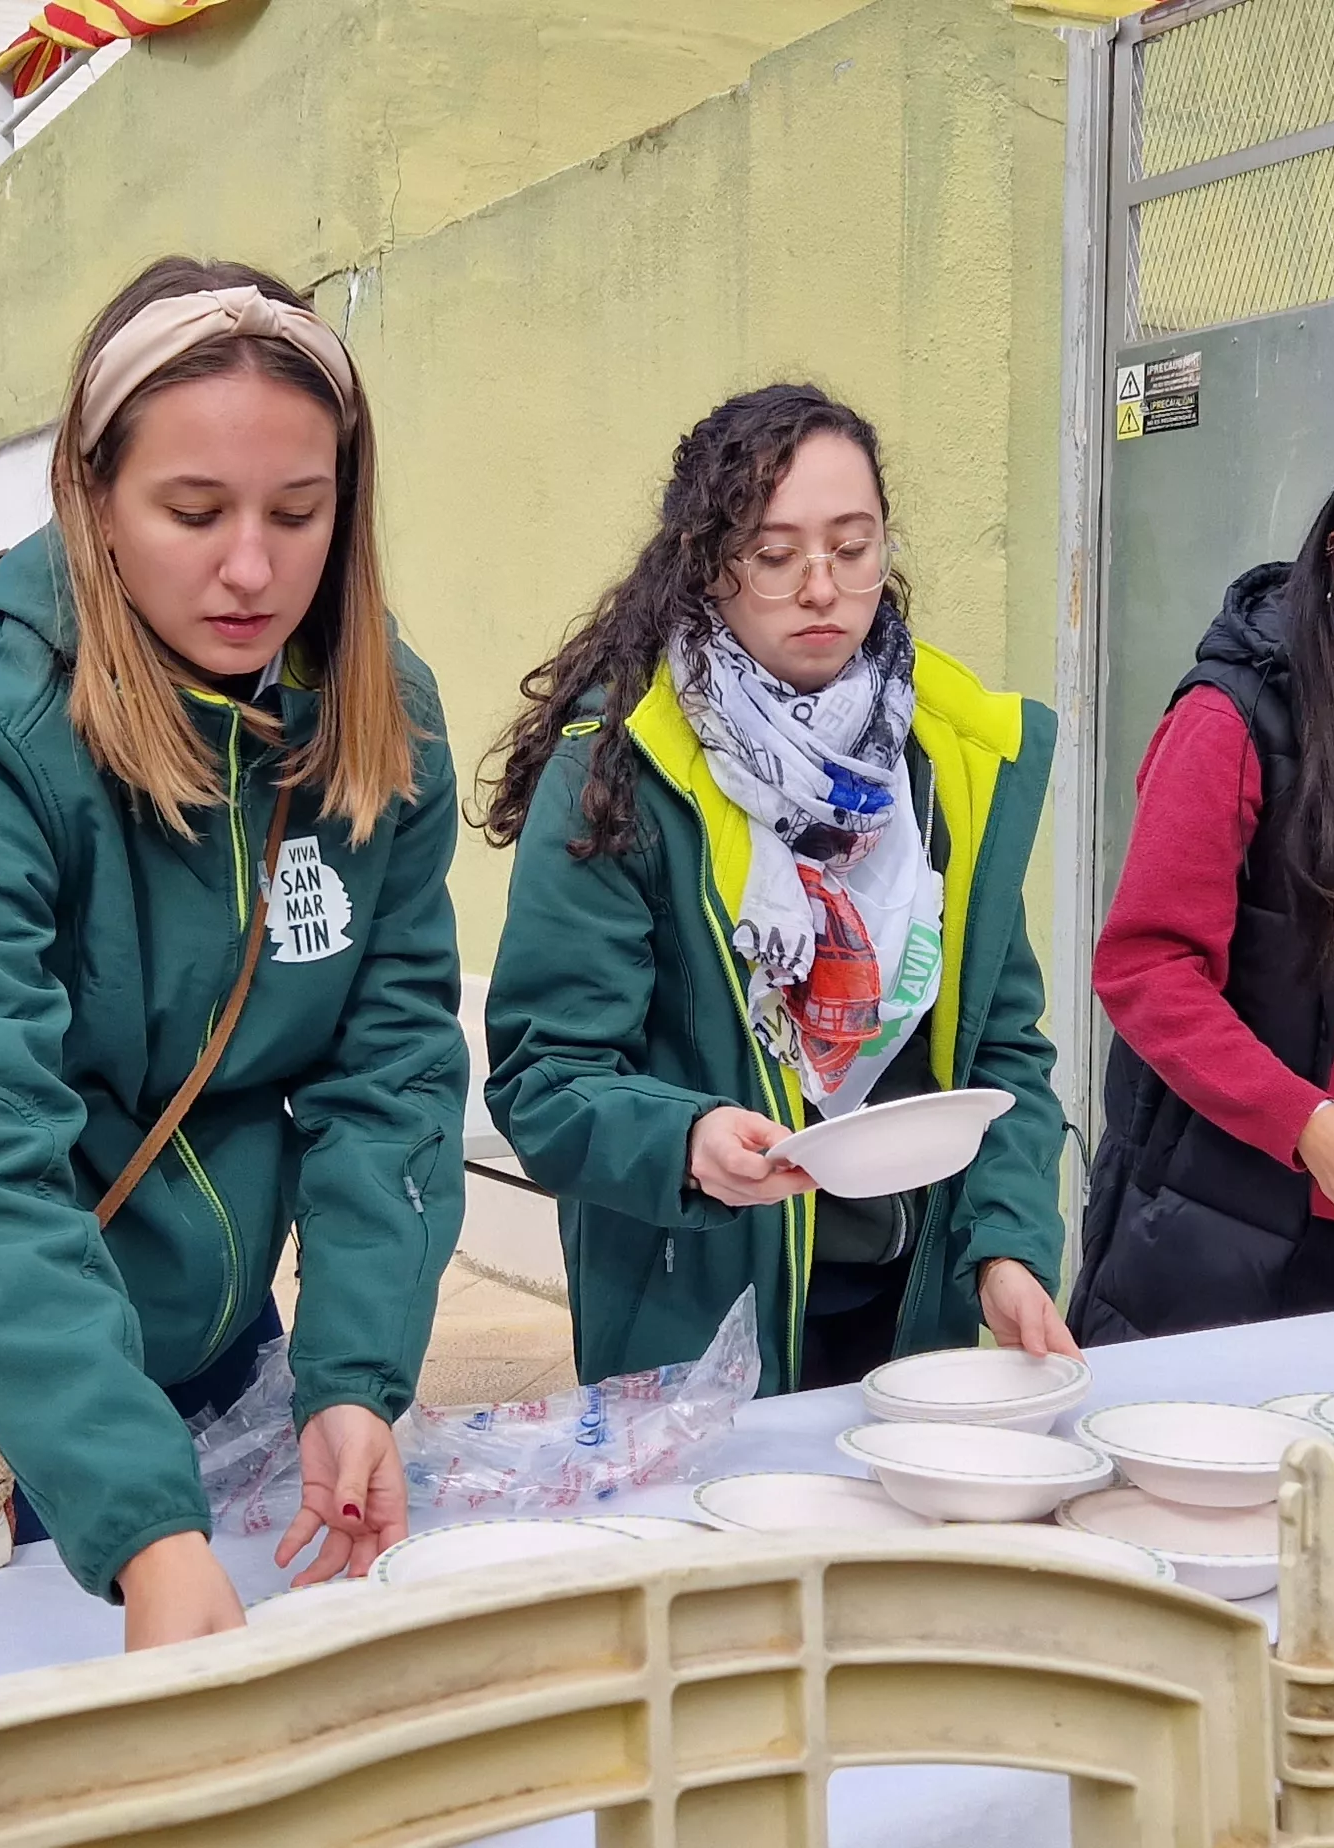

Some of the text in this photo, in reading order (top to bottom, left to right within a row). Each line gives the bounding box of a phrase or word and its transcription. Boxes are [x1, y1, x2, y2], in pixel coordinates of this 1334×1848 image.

[288, 845, 317, 864] VIVA
[280, 865, 321, 895] SAN
[286, 894, 325, 921] MAR
[289, 919, 330, 955] TIN
